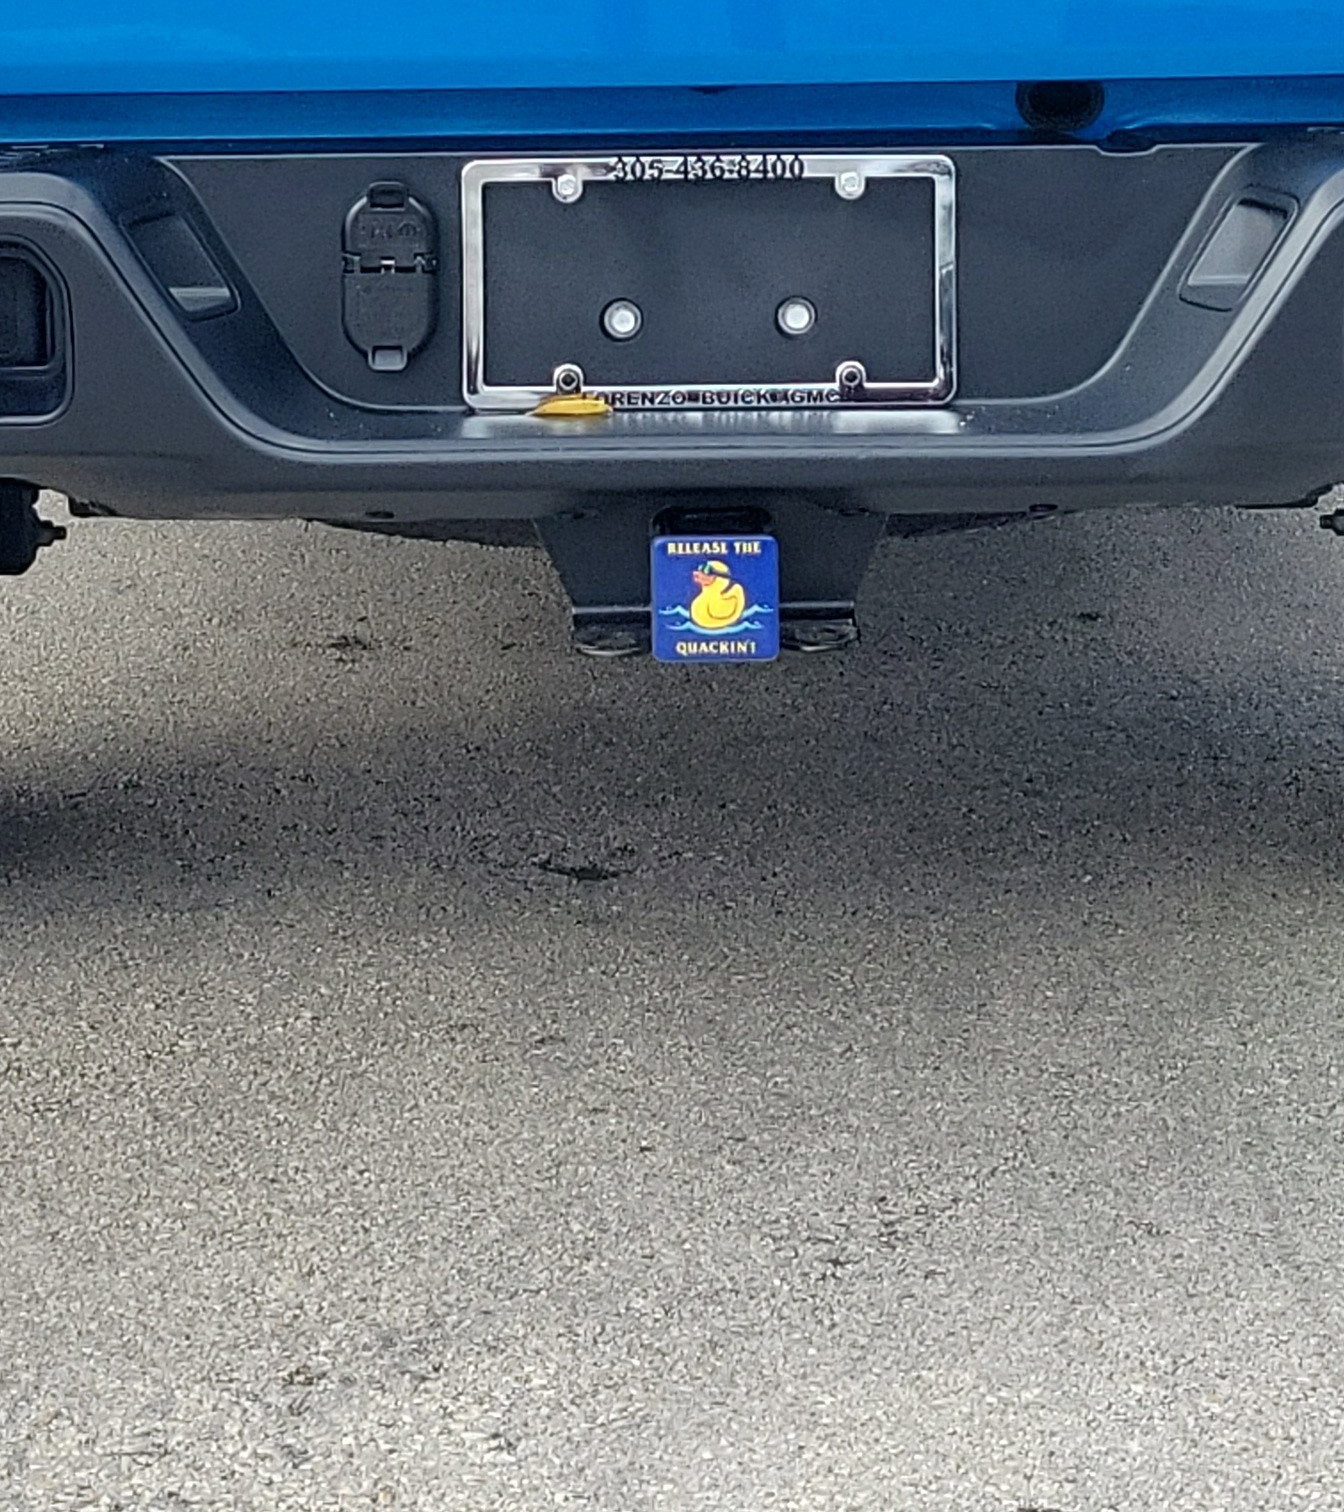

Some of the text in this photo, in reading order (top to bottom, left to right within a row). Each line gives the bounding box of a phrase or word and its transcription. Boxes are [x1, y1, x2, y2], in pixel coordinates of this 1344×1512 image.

[701, 389, 770, 406] BUICK
[790, 388, 840, 404] GMC
[667, 541, 761, 555] RELEASE THE
